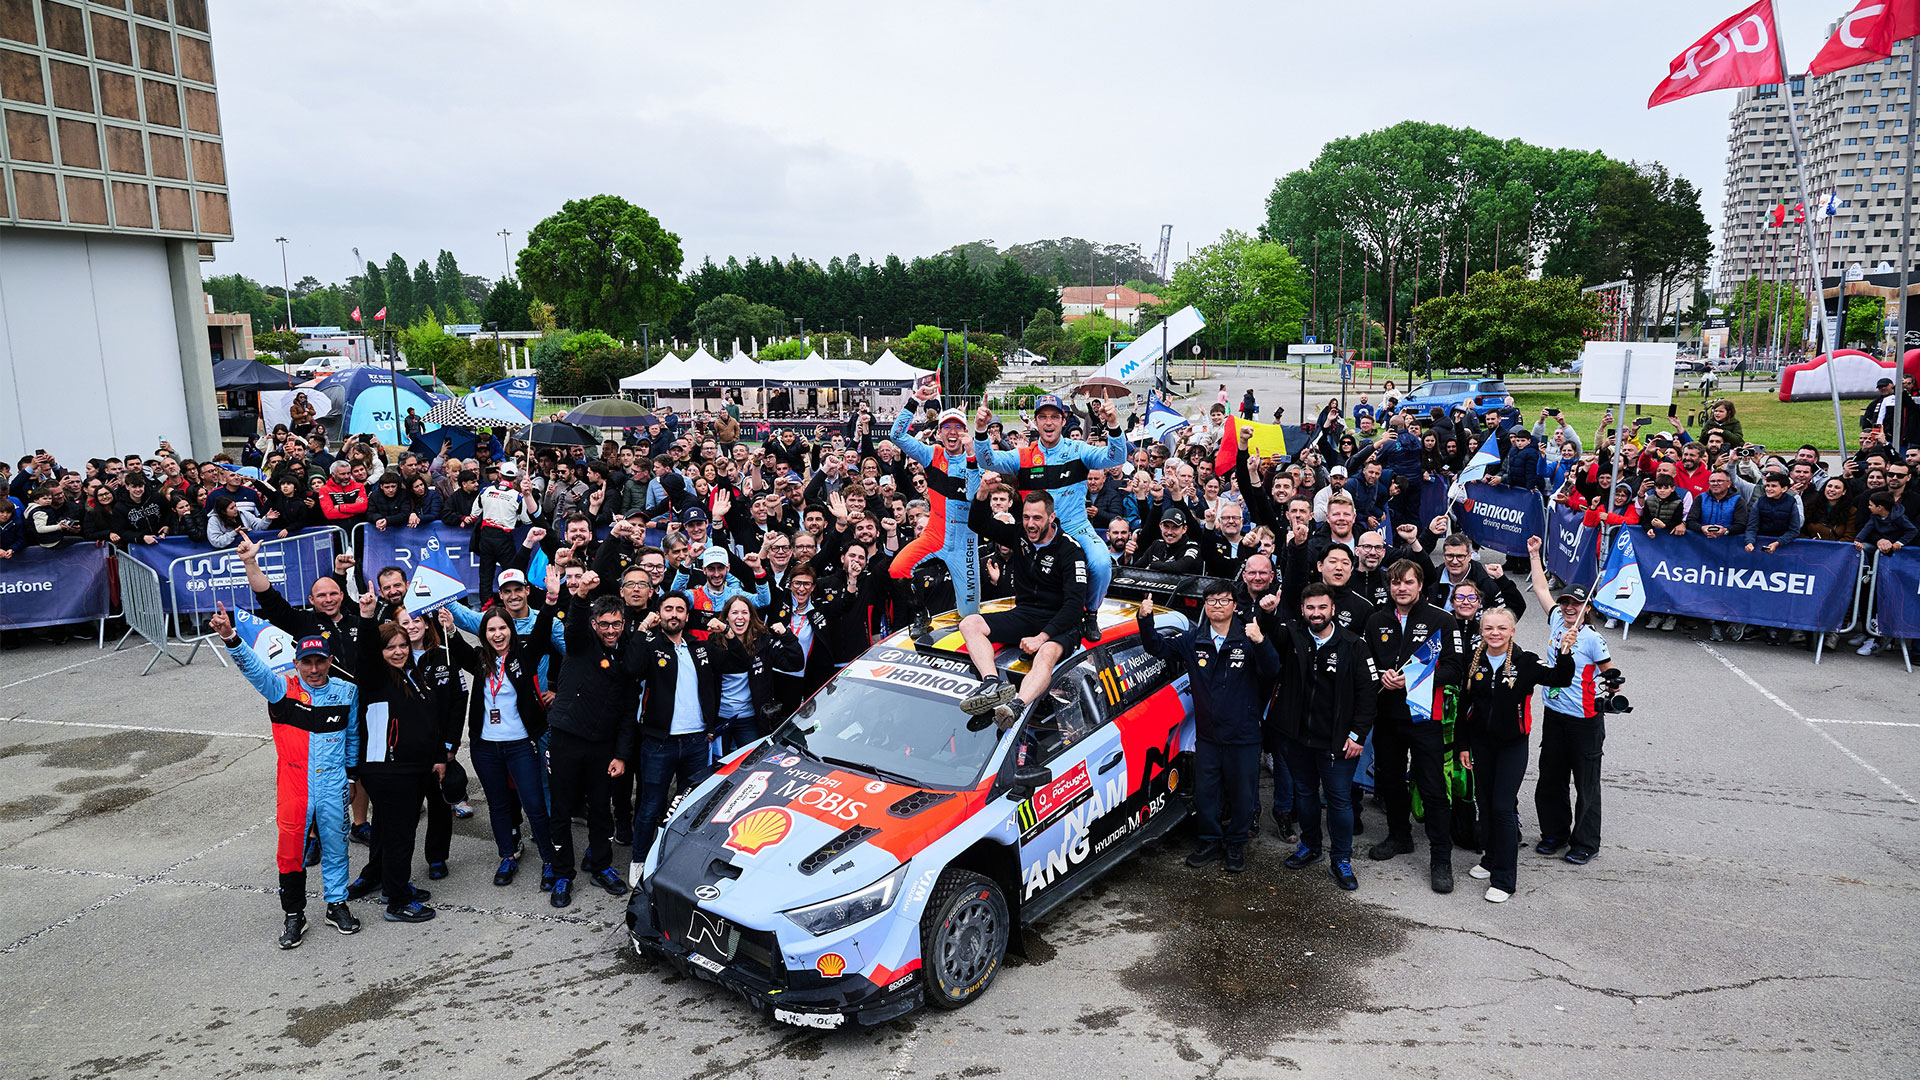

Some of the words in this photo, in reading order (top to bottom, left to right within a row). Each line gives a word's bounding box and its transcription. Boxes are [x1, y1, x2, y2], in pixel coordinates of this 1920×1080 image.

[1483, 518, 1501, 530] driving
[1501, 523, 1522, 534] emotion
[966, 537, 975, 591] WYDAEGHE
[1136, 580, 1178, 591] HYUND
[904, 653, 970, 674] HYUNDAI
[1126, 675, 1137, 690] M.
[1134, 659, 1167, 683] Wydaeghe
[1098, 667, 1121, 706] 11
[784, 767, 843, 789] HYUNDAI
[1052, 769, 1087, 799] Portugal
[773, 779, 868, 820] MOBIS
[1018, 799, 1035, 831] 11
[1064, 771, 1128, 842] NAM
[1128, 792, 1166, 834] MOBIS
[1095, 825, 1127, 854] HYUNDAI
[913, 869, 937, 902] WIA
